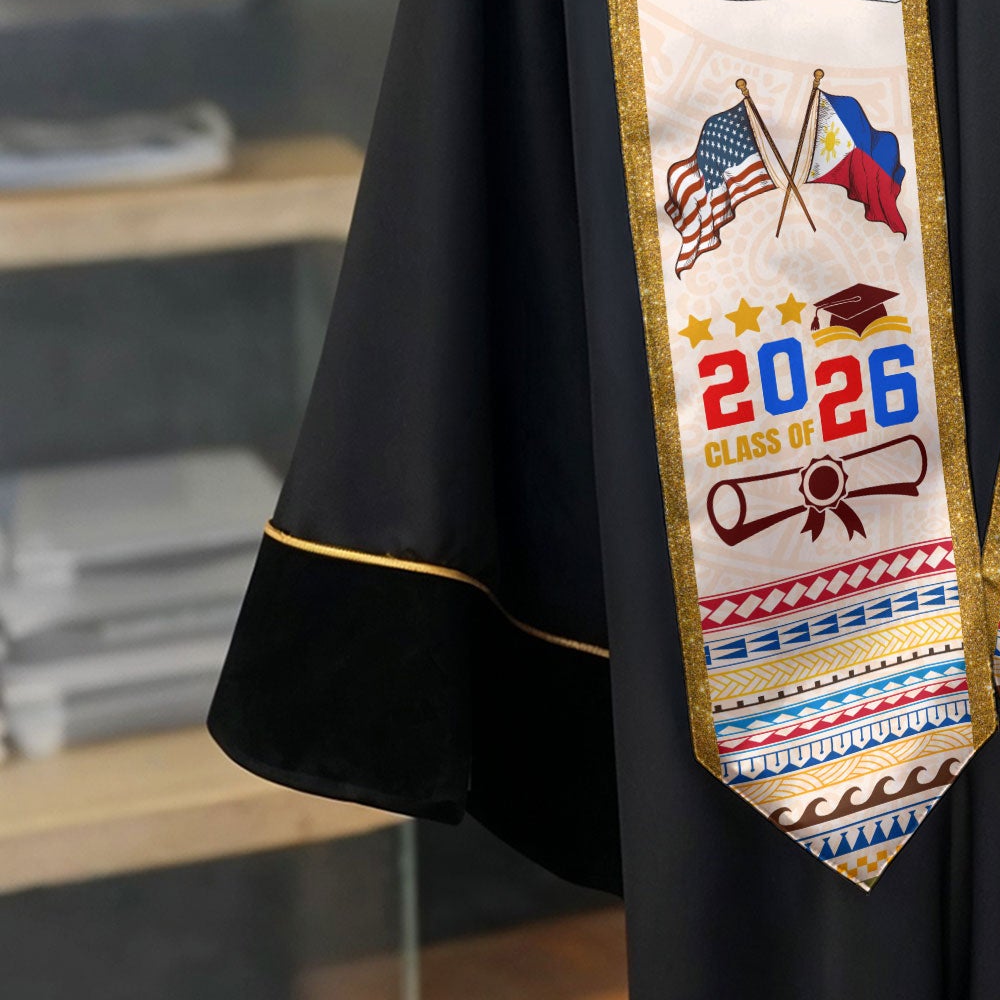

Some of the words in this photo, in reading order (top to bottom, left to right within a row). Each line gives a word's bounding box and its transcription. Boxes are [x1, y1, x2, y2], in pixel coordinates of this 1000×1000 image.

[697, 336, 919, 443] 2026
[704, 427, 782, 468] CLASS
[787, 418, 815, 449] OF
